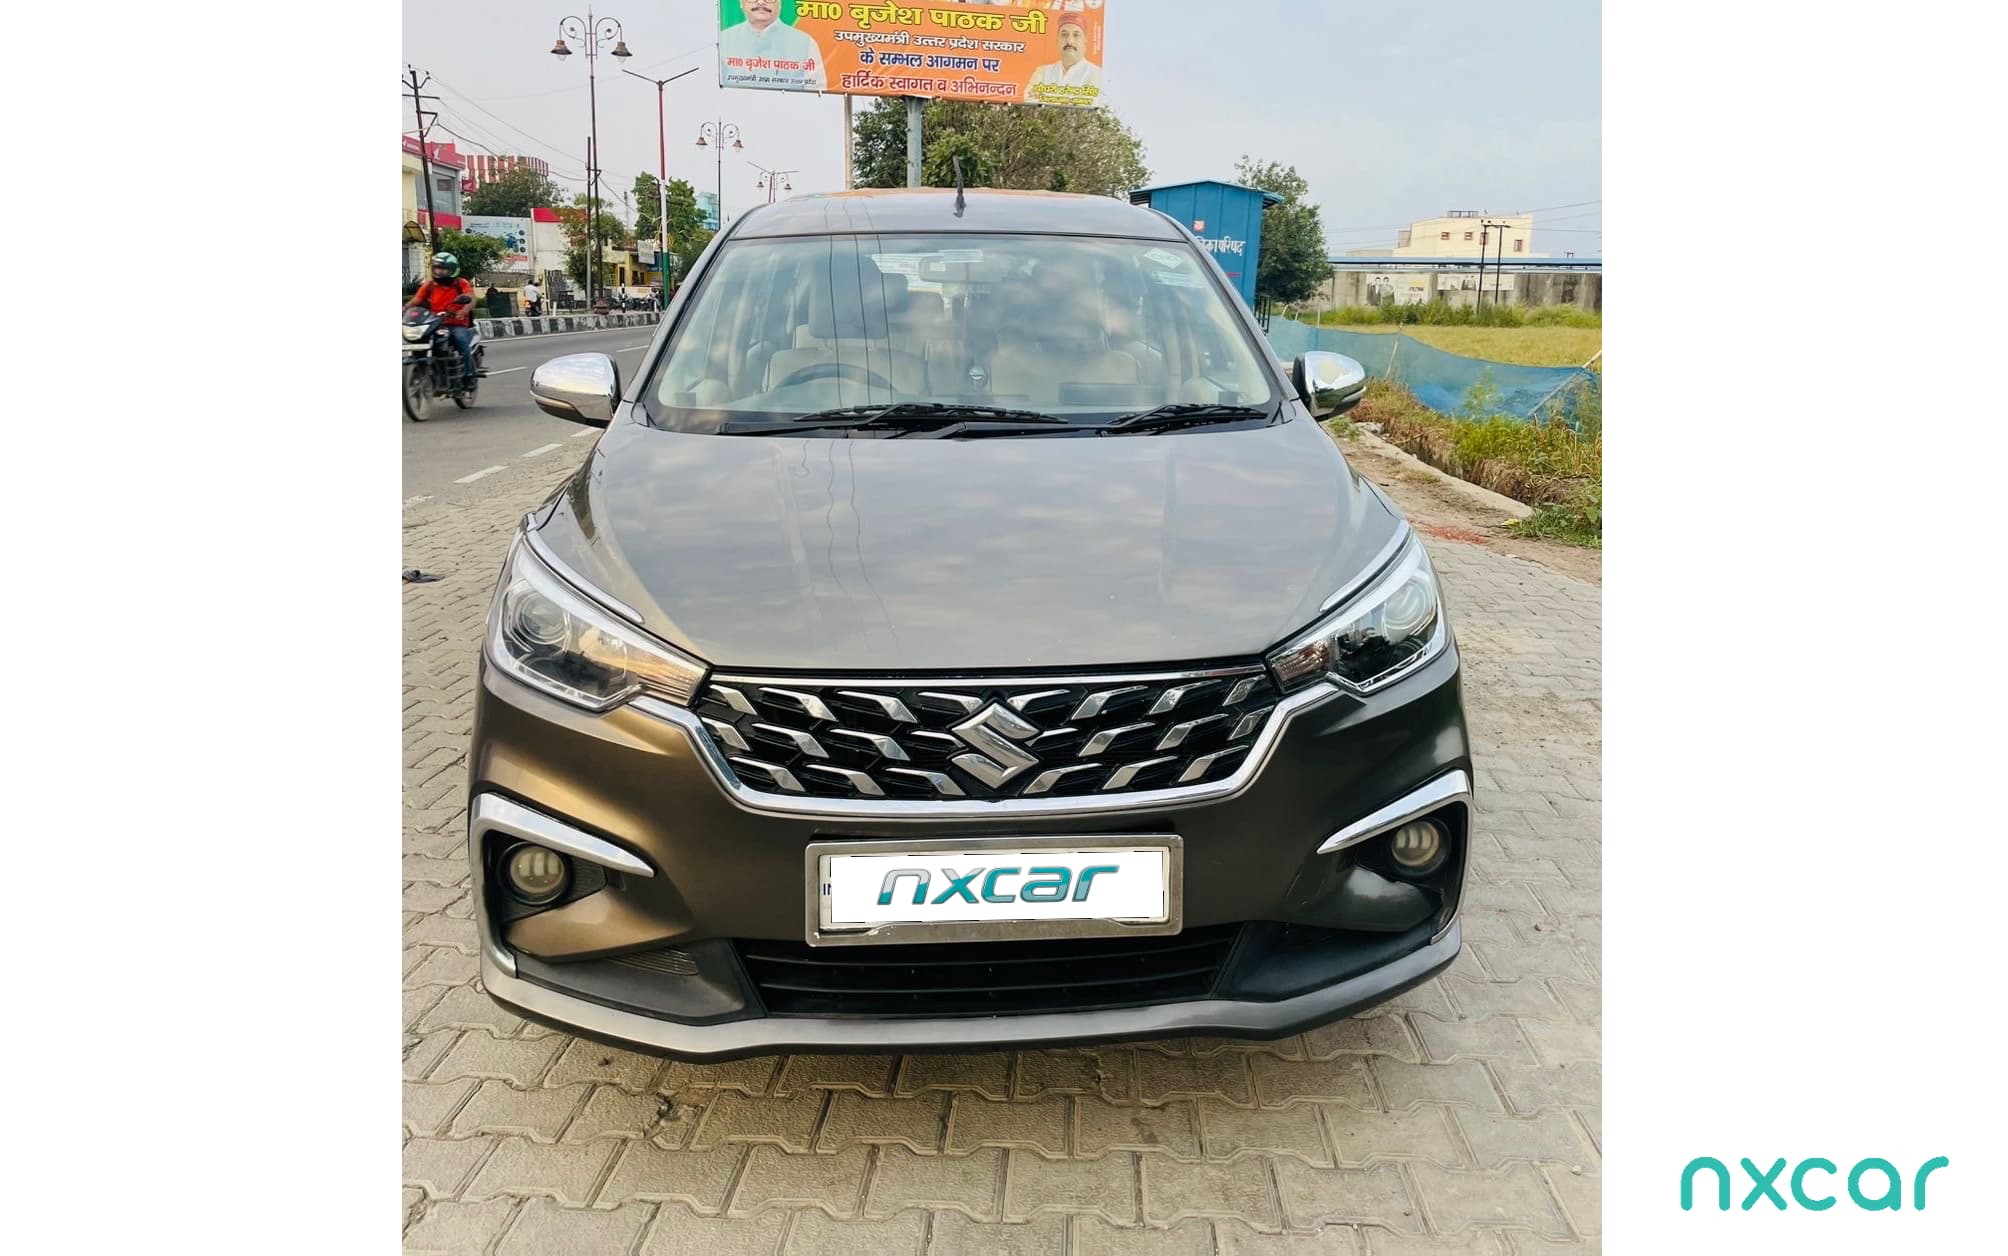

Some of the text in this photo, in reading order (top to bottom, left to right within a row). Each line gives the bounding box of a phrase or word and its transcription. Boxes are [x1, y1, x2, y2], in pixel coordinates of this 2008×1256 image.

[849, 0, 923, 29] बृजेश
[929, 8, 1005, 31] पाठक
[1010, 9, 1048, 34] जी
[834, 30, 1026, 53] उपमुख्यमंत्री उत्तर प्रदेश सरकार
[774, 59, 799, 71] पाठक
[802, 58, 816, 72] जी
[860, 49, 1000, 72] के सम्भल आगमन पर
[842, 70, 1018, 97] हार्दिक स्वागत व अभिनन्दन
